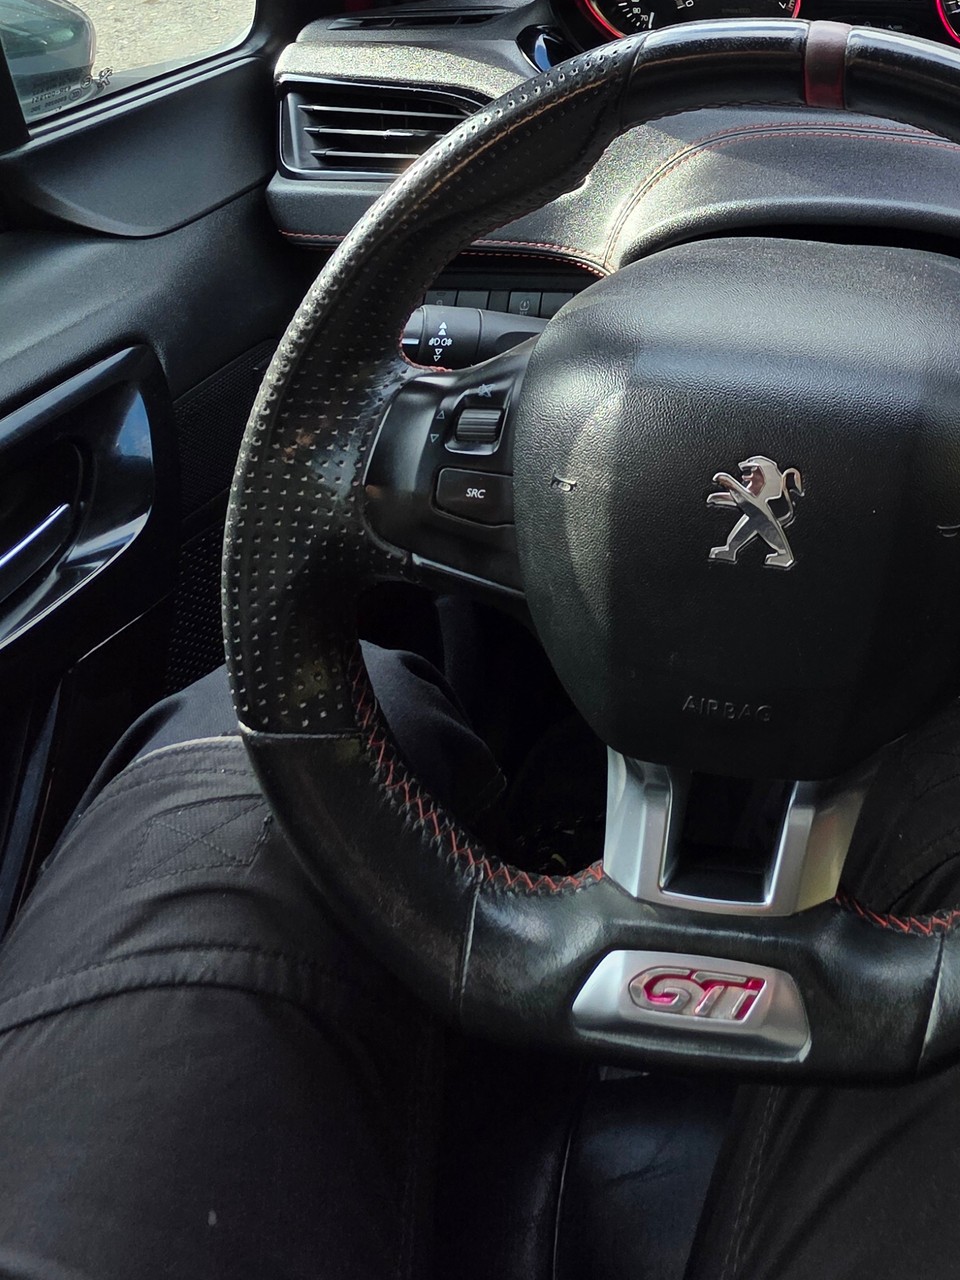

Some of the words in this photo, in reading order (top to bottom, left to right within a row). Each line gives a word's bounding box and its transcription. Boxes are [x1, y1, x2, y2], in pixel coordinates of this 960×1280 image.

[779, 1, 786, 9] 7
[466, 488, 486, 498] SRC
[683, 695, 772, 722] AIRBAG
